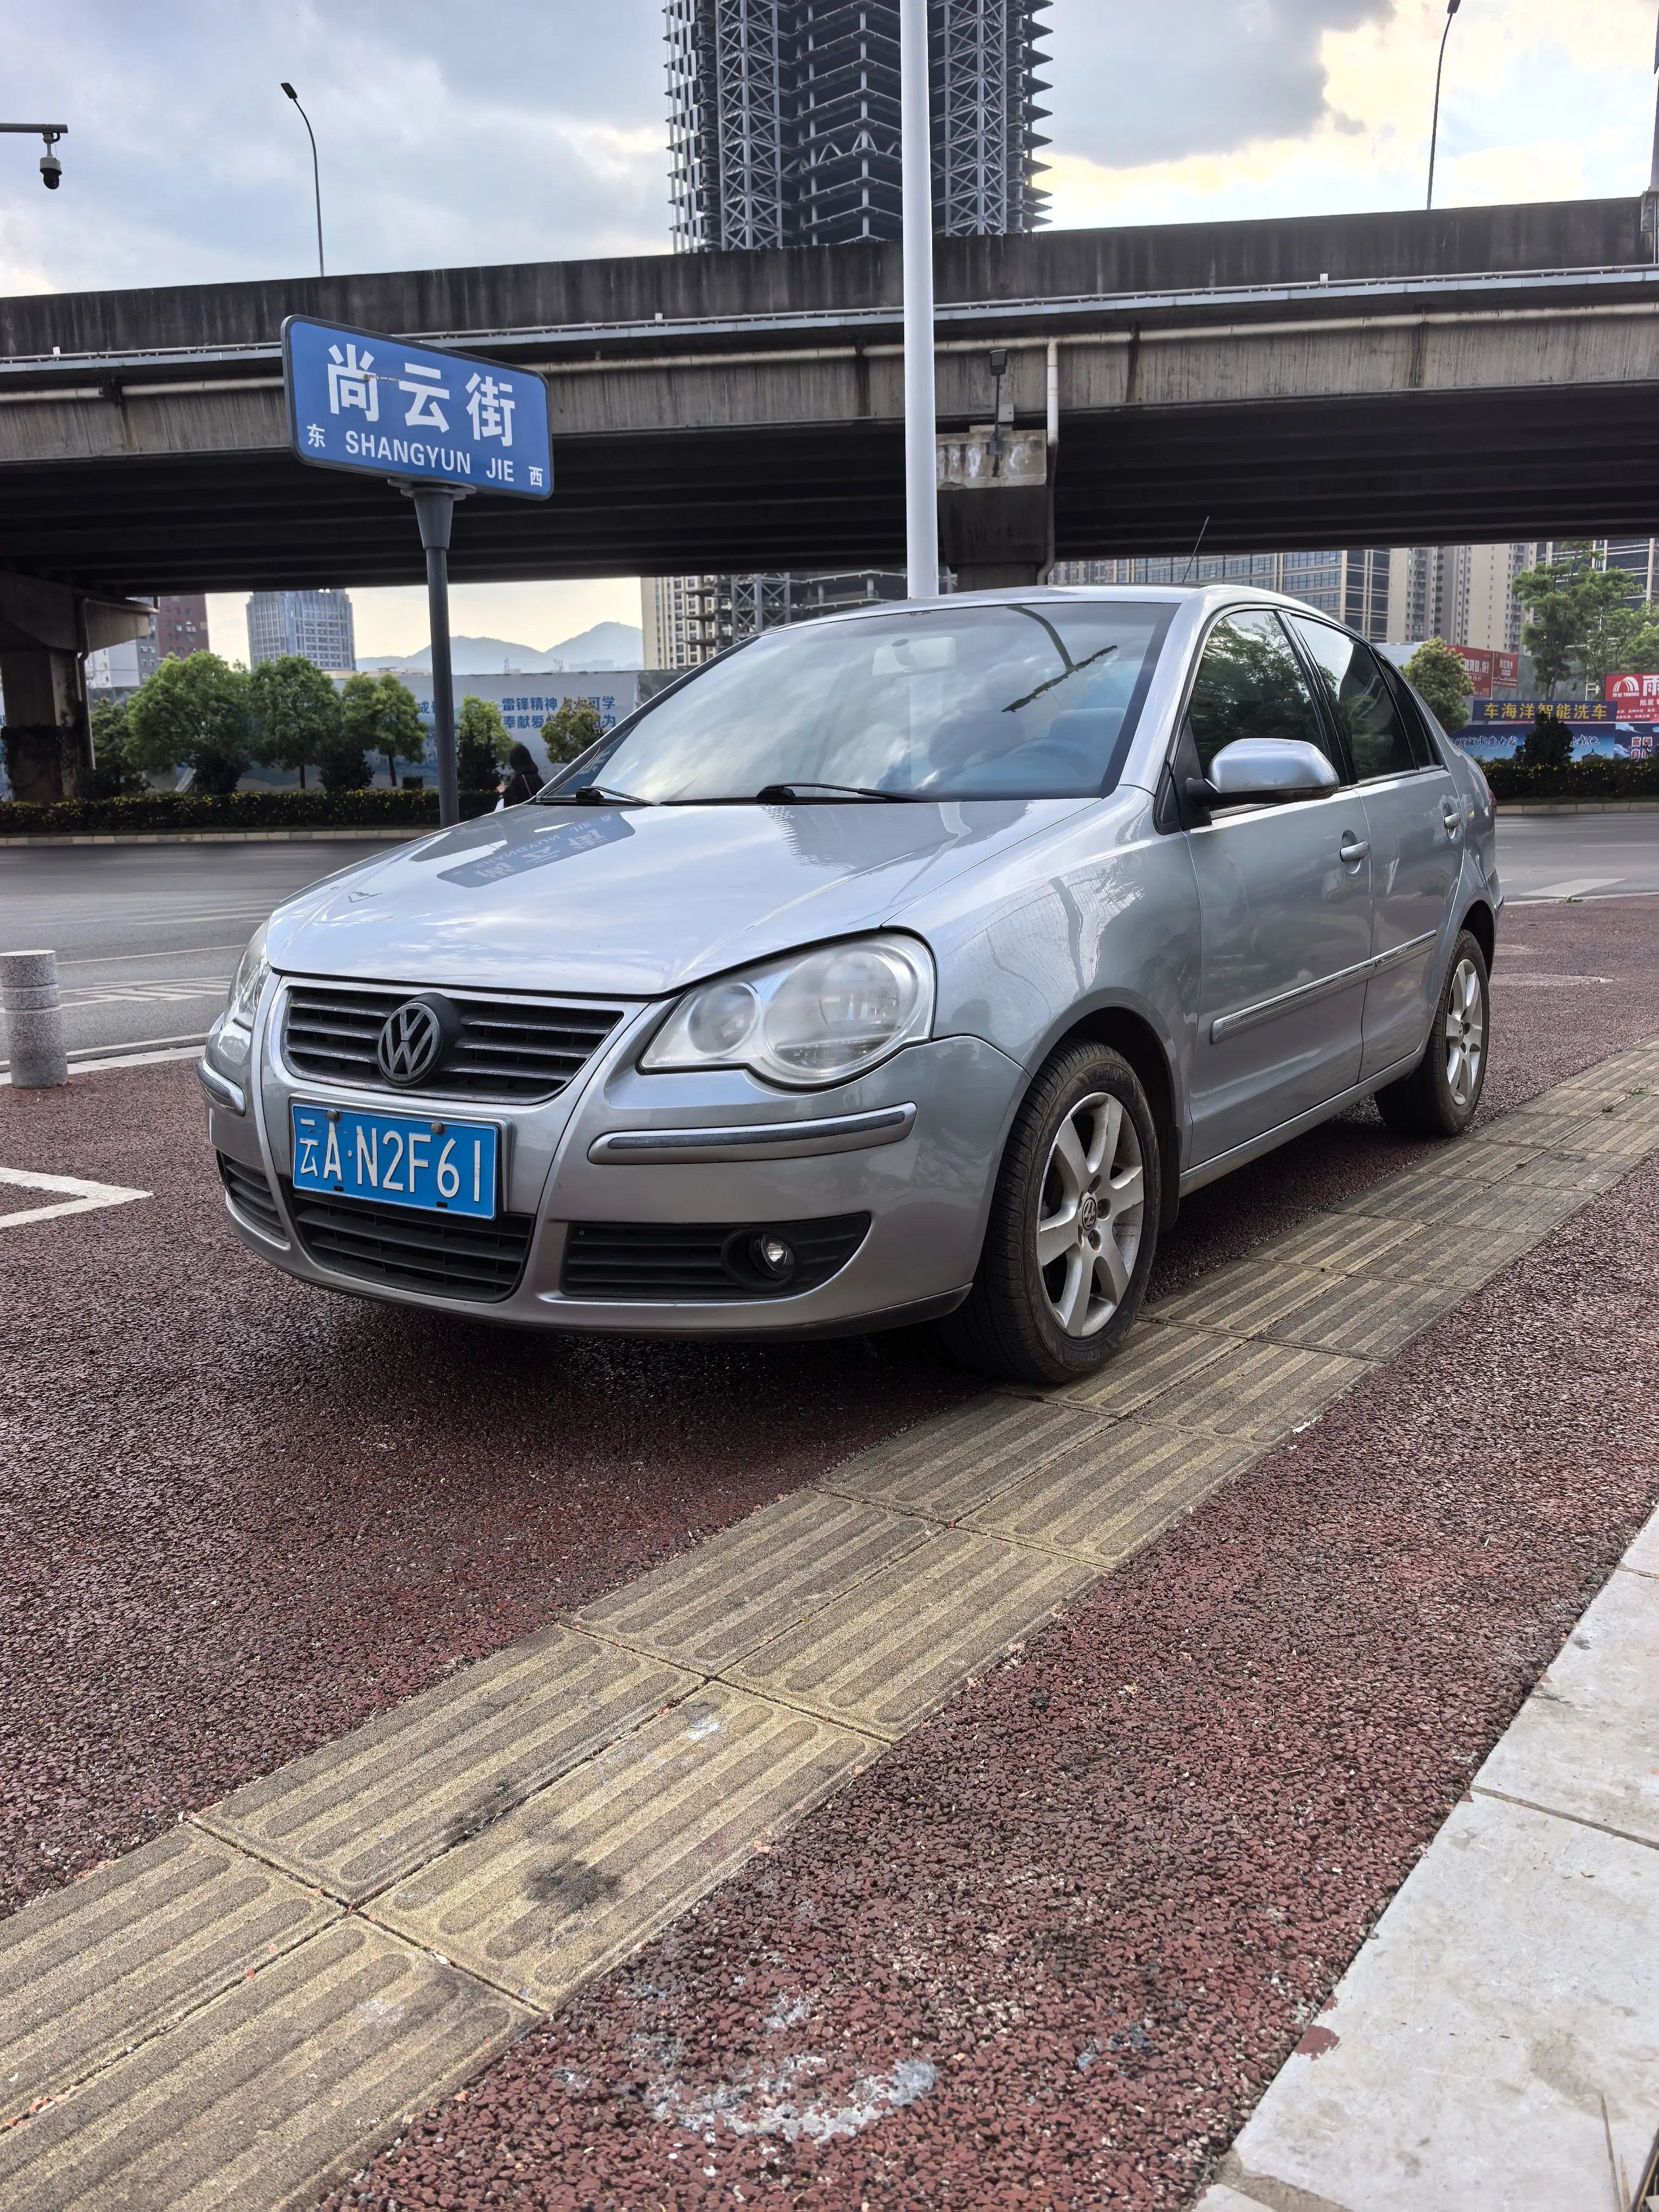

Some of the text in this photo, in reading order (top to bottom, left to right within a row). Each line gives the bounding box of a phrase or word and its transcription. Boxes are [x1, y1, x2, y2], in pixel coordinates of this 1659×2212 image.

[327, 343, 516, 447] 尚云街
[307, 423, 326, 448] 东
[346, 430, 514, 482] SHANGYUN JIE
[528, 466, 544, 487] 西
[1483, 703, 1608, 720] 车海洋智能洗车
